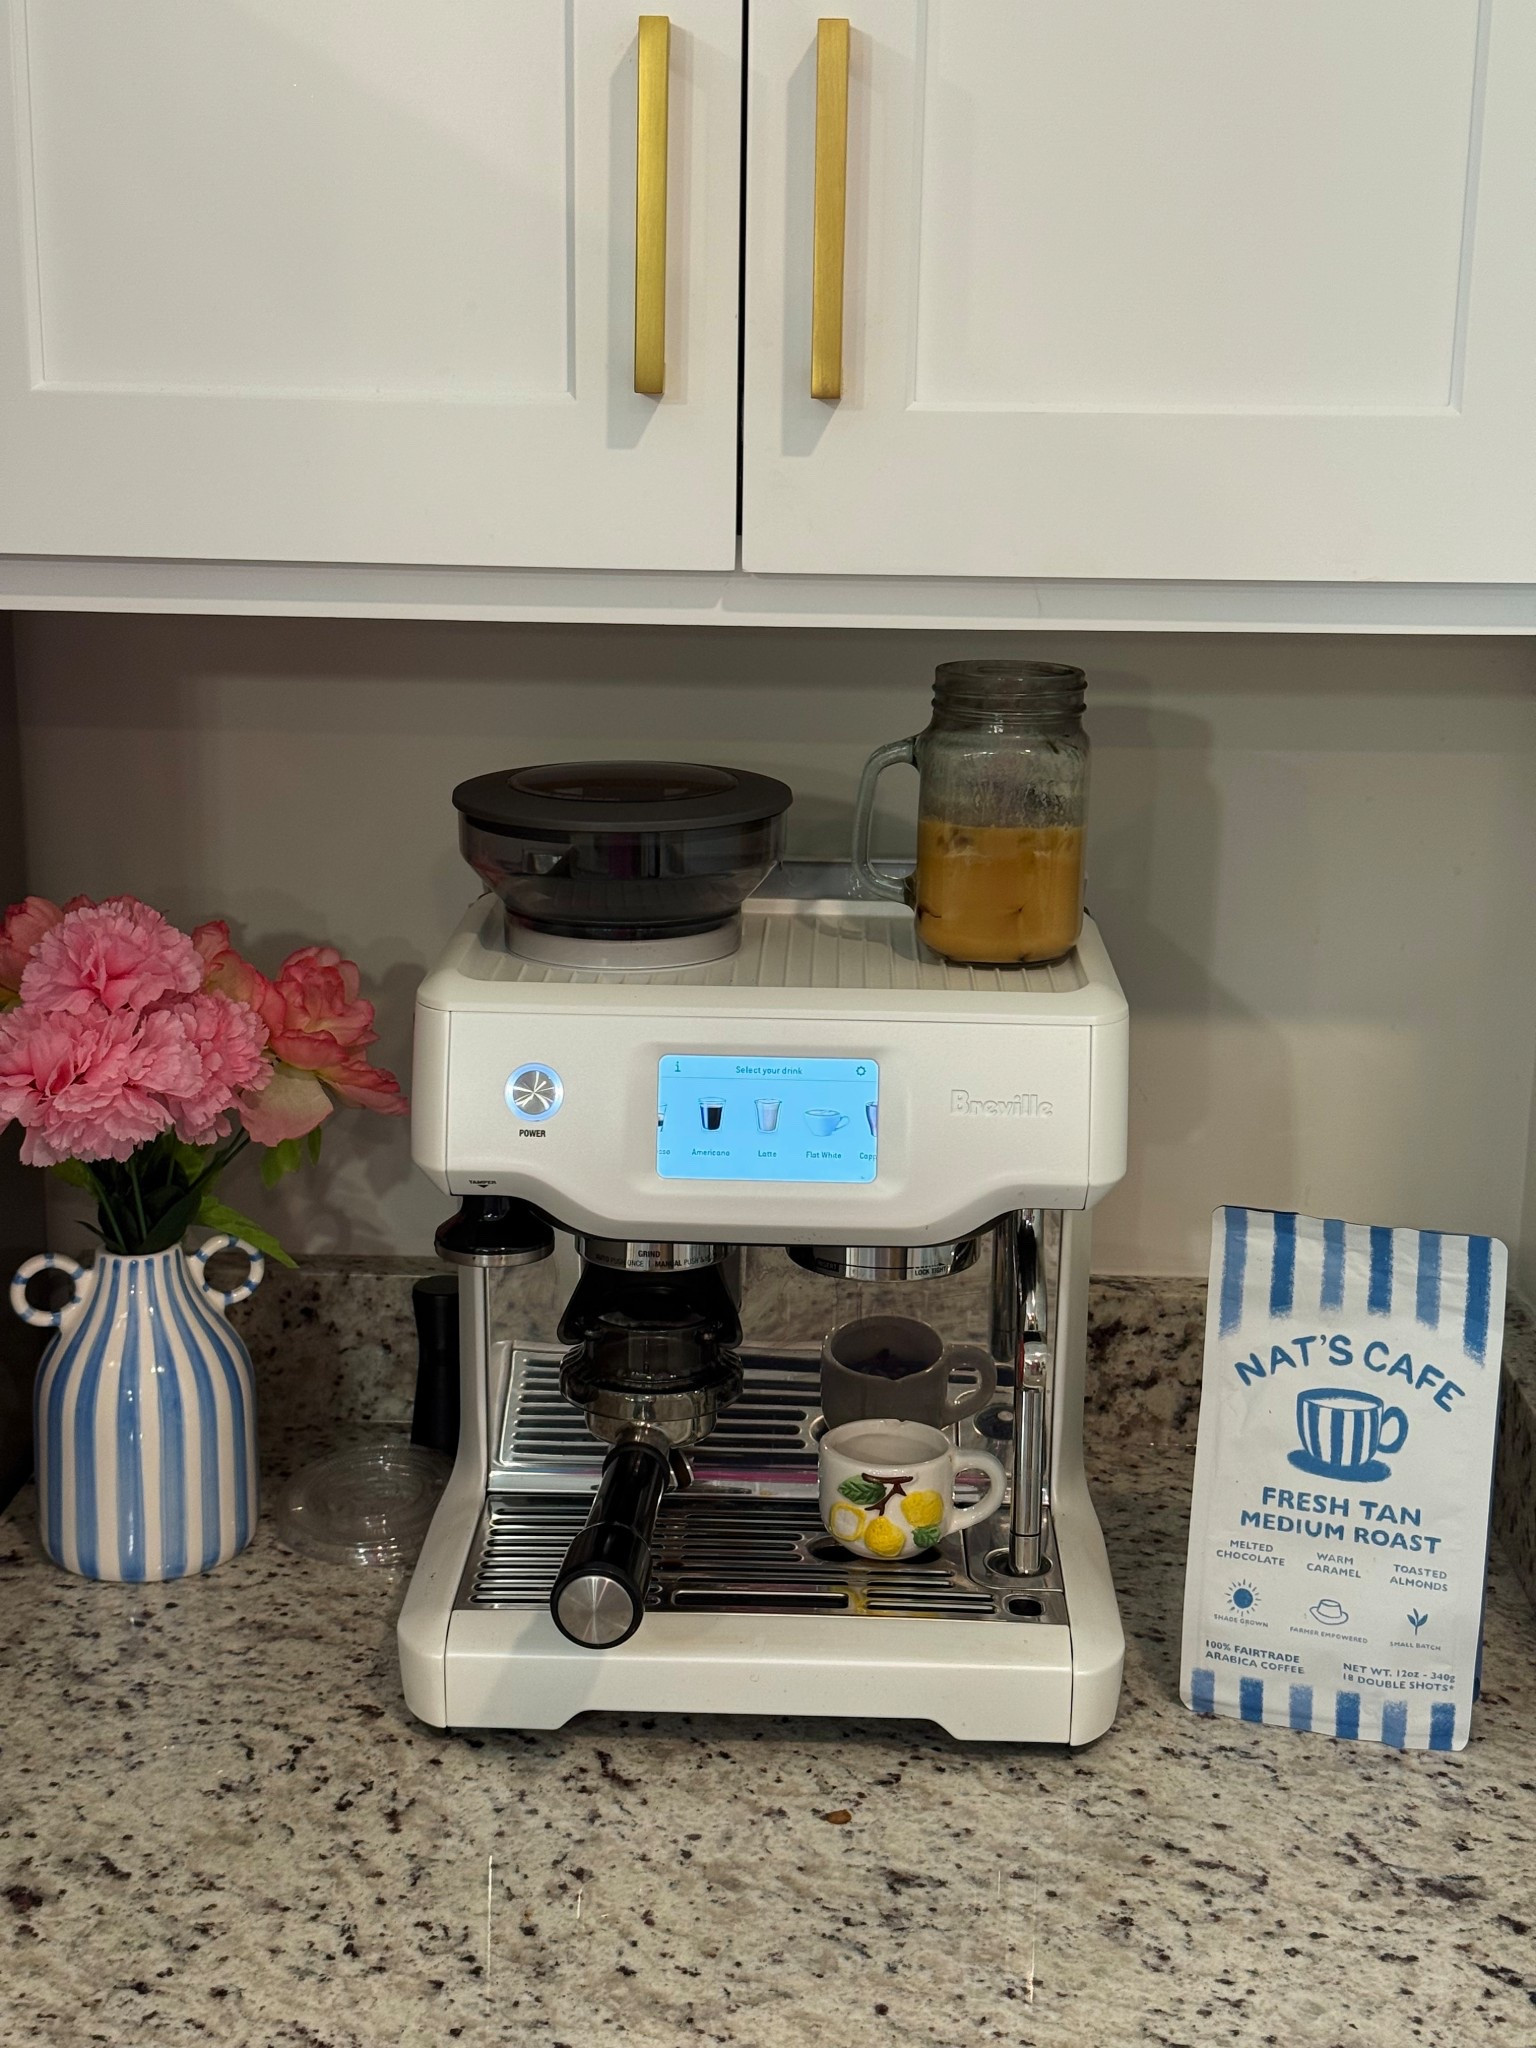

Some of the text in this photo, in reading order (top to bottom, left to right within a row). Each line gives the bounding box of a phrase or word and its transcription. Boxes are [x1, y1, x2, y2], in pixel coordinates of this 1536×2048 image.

[735, 1065, 802, 1076] Select your drink
[950, 1089, 1053, 1117] Breville
[518, 1129, 546, 1138] POWER
[691, 1148, 731, 1157] Americano
[757, 1150, 777, 1158] Latte
[806, 1151, 842, 1160] Flat White
[638, 1250, 660, 1258] GRIND
[914, 1268, 929, 1276] LOCK
[1234, 1334, 1466, 1413] NAT'S CAFE
[1262, 1486, 1421, 1526] FRESH TAN
[1240, 1510, 1442, 1554] MEDIUM ROAST
[1229, 1539, 1273, 1553] MELTED
[1216, 1549, 1285, 1567] CHOCOLATE
[1316, 1552, 1354, 1565] WARM
[1306, 1563, 1362, 1579] CARAMEL
[1393, 1564, 1447, 1580] TOASTED
[1389, 1576, 1448, 1592] ALMONDS
[1213, 1613, 1269, 1628] SHADE GROWN
[1289, 1626, 1368, 1644] FARMER EMPOWERED
[1205, 1639, 1300, 1664] 100% FAIRTRADE
[1389, 1641, 1441, 1651] SMALL BATCH
[1205, 1651, 1305, 1675] ARABICA COFFEE
[1343, 1662, 1367, 1674] NET
[1370, 1666, 1392, 1677] WT.
[1396, 1669, 1420, 1679] 12oz
[1430, 1671, 1456, 1684] 340g
[1343, 1672, 1354, 1682] 18
[1357, 1675, 1406, 1690] DOUBLE
